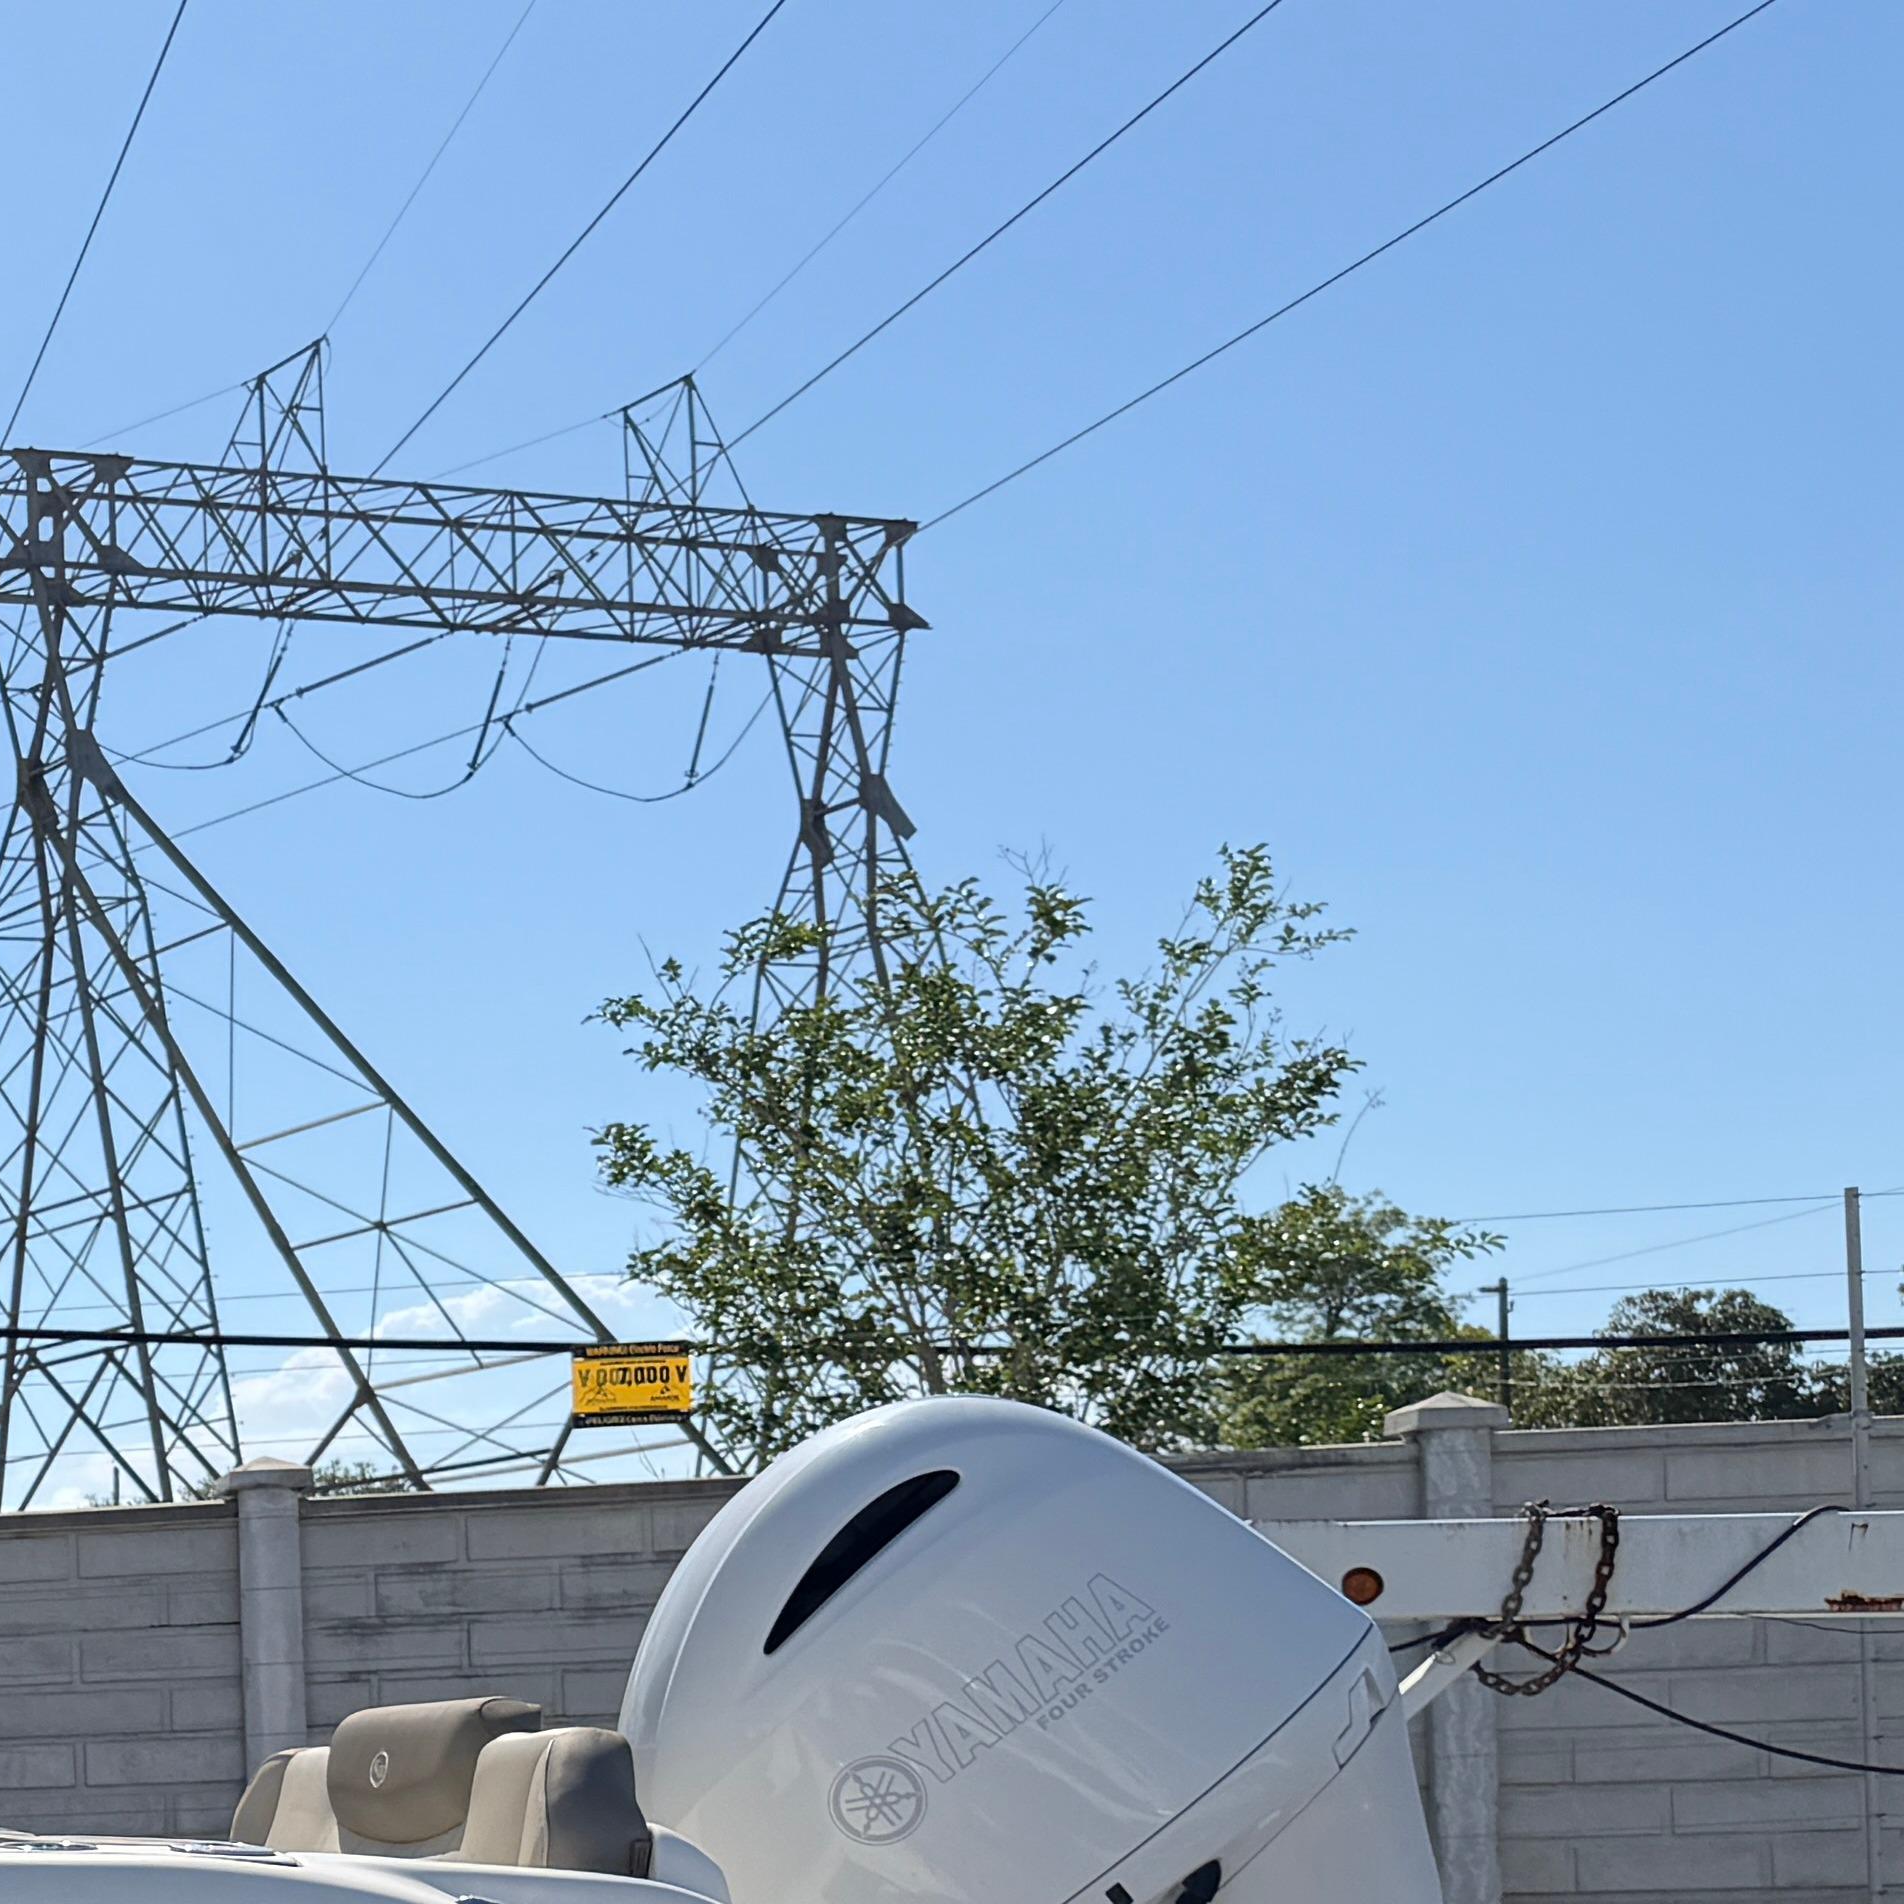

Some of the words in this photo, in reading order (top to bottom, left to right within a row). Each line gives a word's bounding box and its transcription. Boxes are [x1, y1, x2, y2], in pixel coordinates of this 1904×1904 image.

[887, 1572, 1156, 1784] YAMAHA
[1037, 1681, 1094, 1731] FOUR
[1095, 1615, 1171, 1684] STROKE
